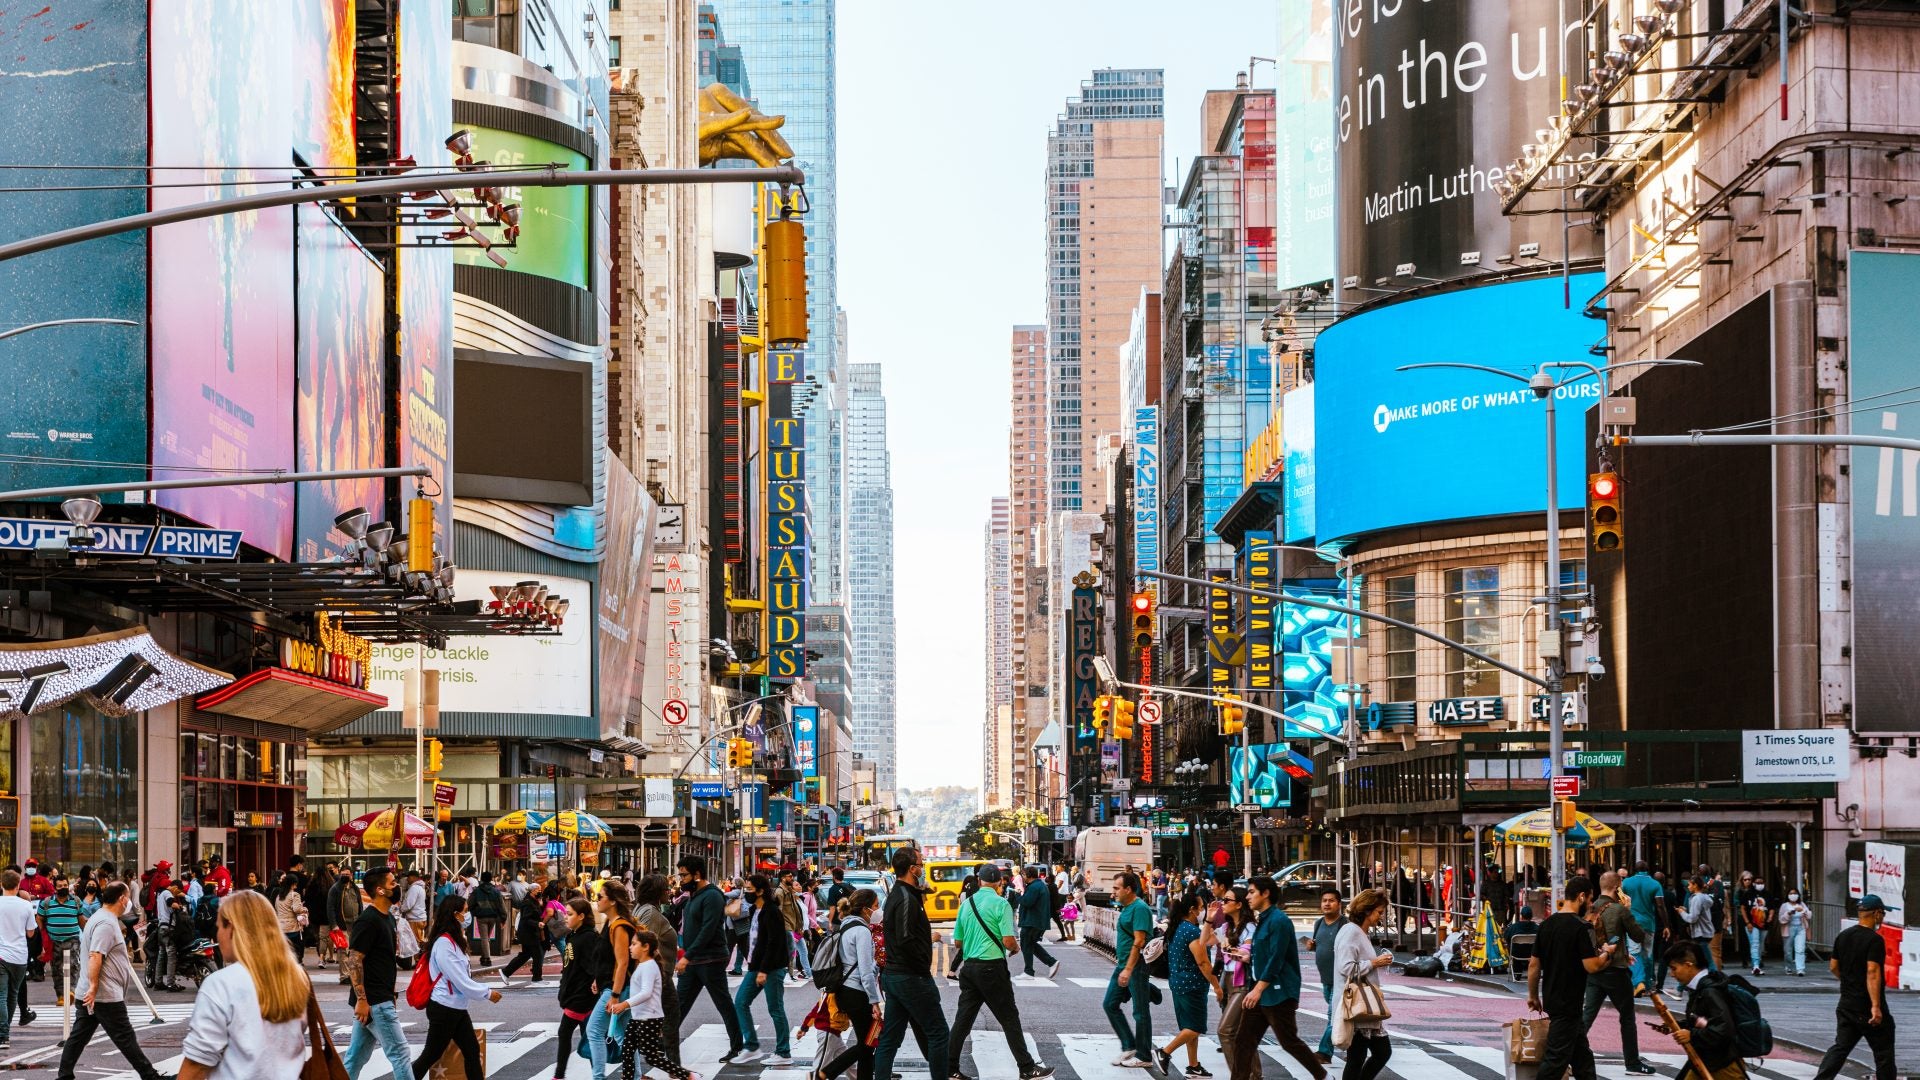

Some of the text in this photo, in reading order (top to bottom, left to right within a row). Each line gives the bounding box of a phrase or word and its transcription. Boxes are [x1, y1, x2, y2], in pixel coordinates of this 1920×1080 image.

[1358, 67, 1386, 131] in
[1397, 38, 1488, 110] the
[1365, 181, 1422, 225] Martin
[1389, 405, 1418, 422] MAKE
[1421, 399, 1457, 416] MORE
[1461, 396, 1479, 410] OF
[1555, 382, 1600, 399] OURS
[1136, 408, 1156, 446] NEW
[162, 531, 233, 554] PRIME
[774, 419, 800, 676] TUSSAUD'S
[653, 555, 665, 564] EW
[1251, 537, 1270, 687] NEW VICTORY
[443, 646, 489, 660] tackle
[1075, 595, 1095, 738] REGAL
[745, 723, 765, 735] SIX
[1755, 735, 1835, 747] 1 Times Square
[1578, 753, 1622, 767] Broadway
[1755, 756, 1835, 766] Jamestown OTS, L.P.
